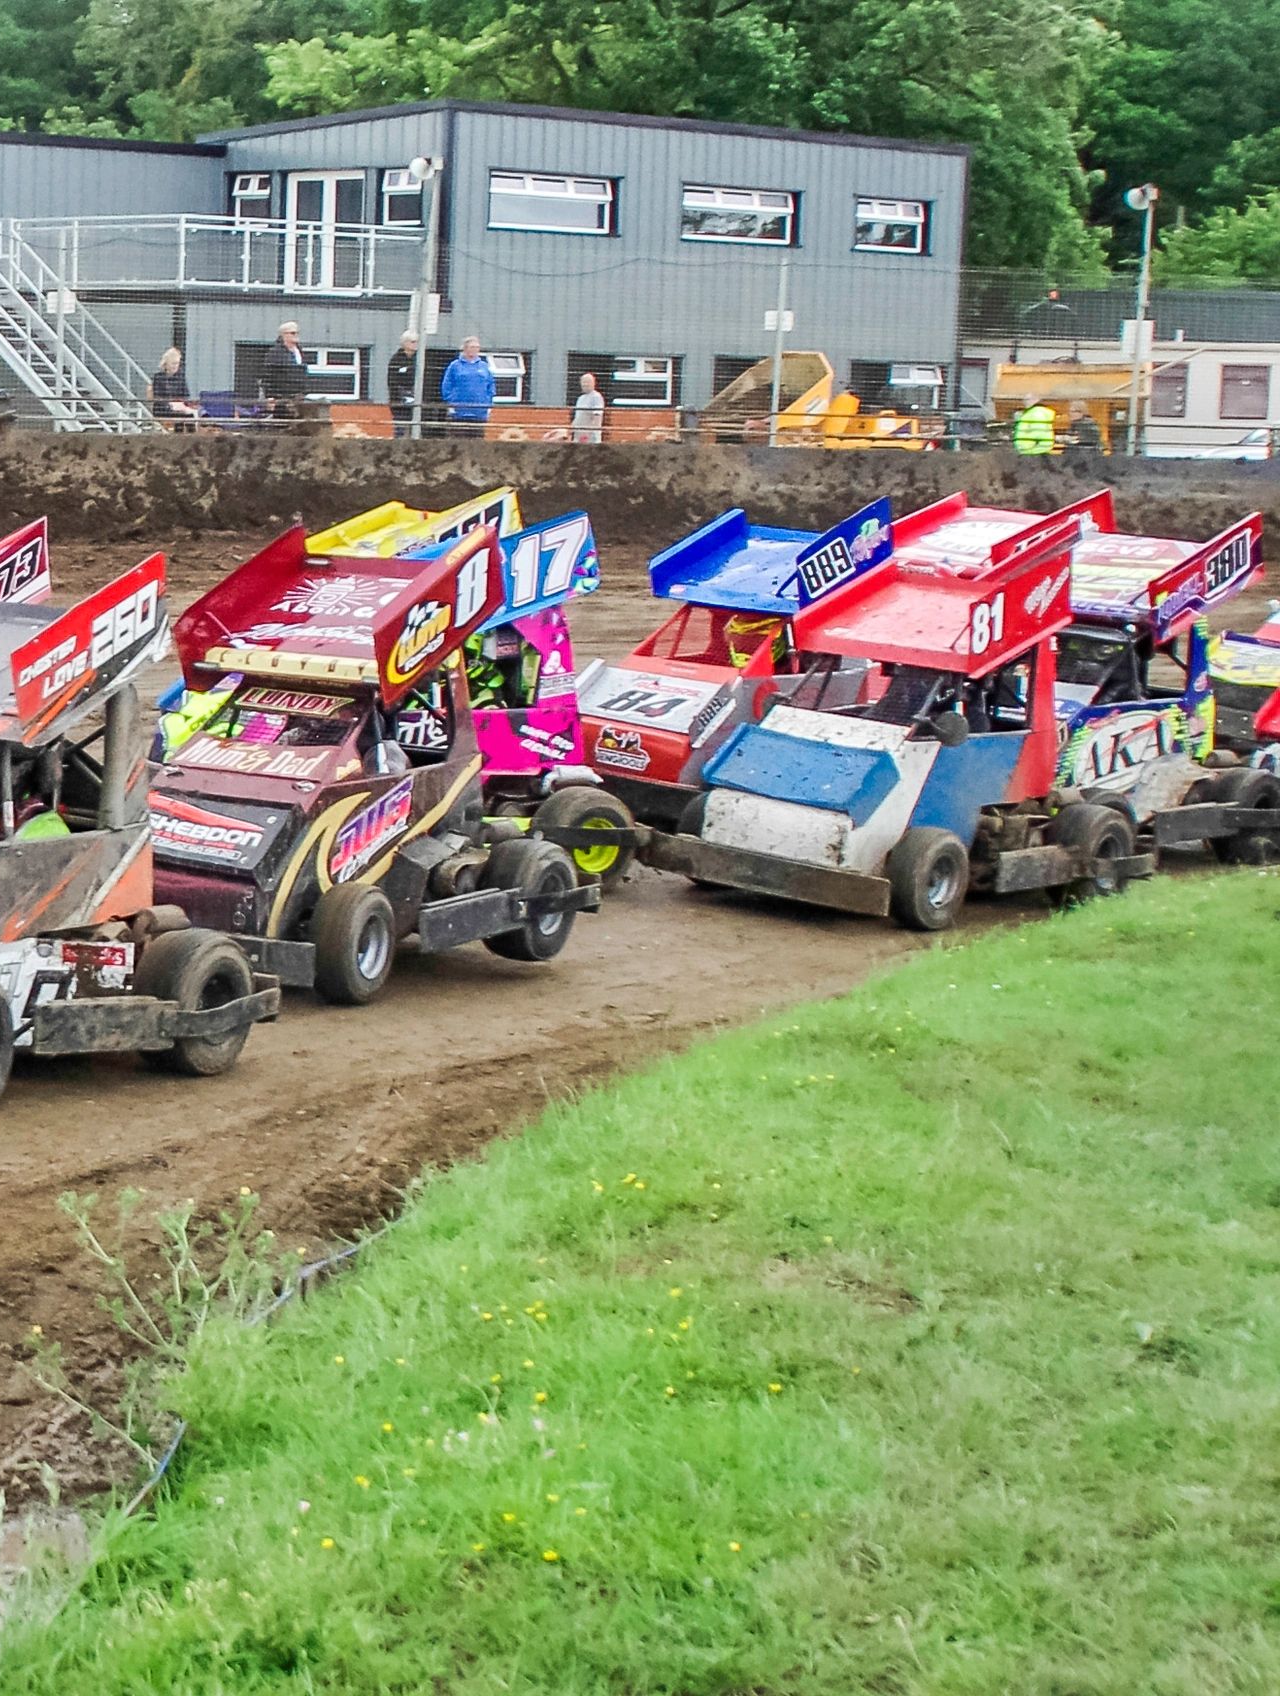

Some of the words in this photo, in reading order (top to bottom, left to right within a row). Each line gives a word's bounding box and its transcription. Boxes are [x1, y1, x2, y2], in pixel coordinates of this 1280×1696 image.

[455, 548, 490, 628] 8
[511, 516, 589, 608] 17
[801, 541, 854, 595] 889
[1206, 533, 1248, 592] 380
[91, 579, 159, 670] 260
[971, 592, 1005, 655] 81
[241, 687, 340, 715] LUNDY
[175, 738, 245, 768] Mum
[263, 751, 331, 777] Dad
